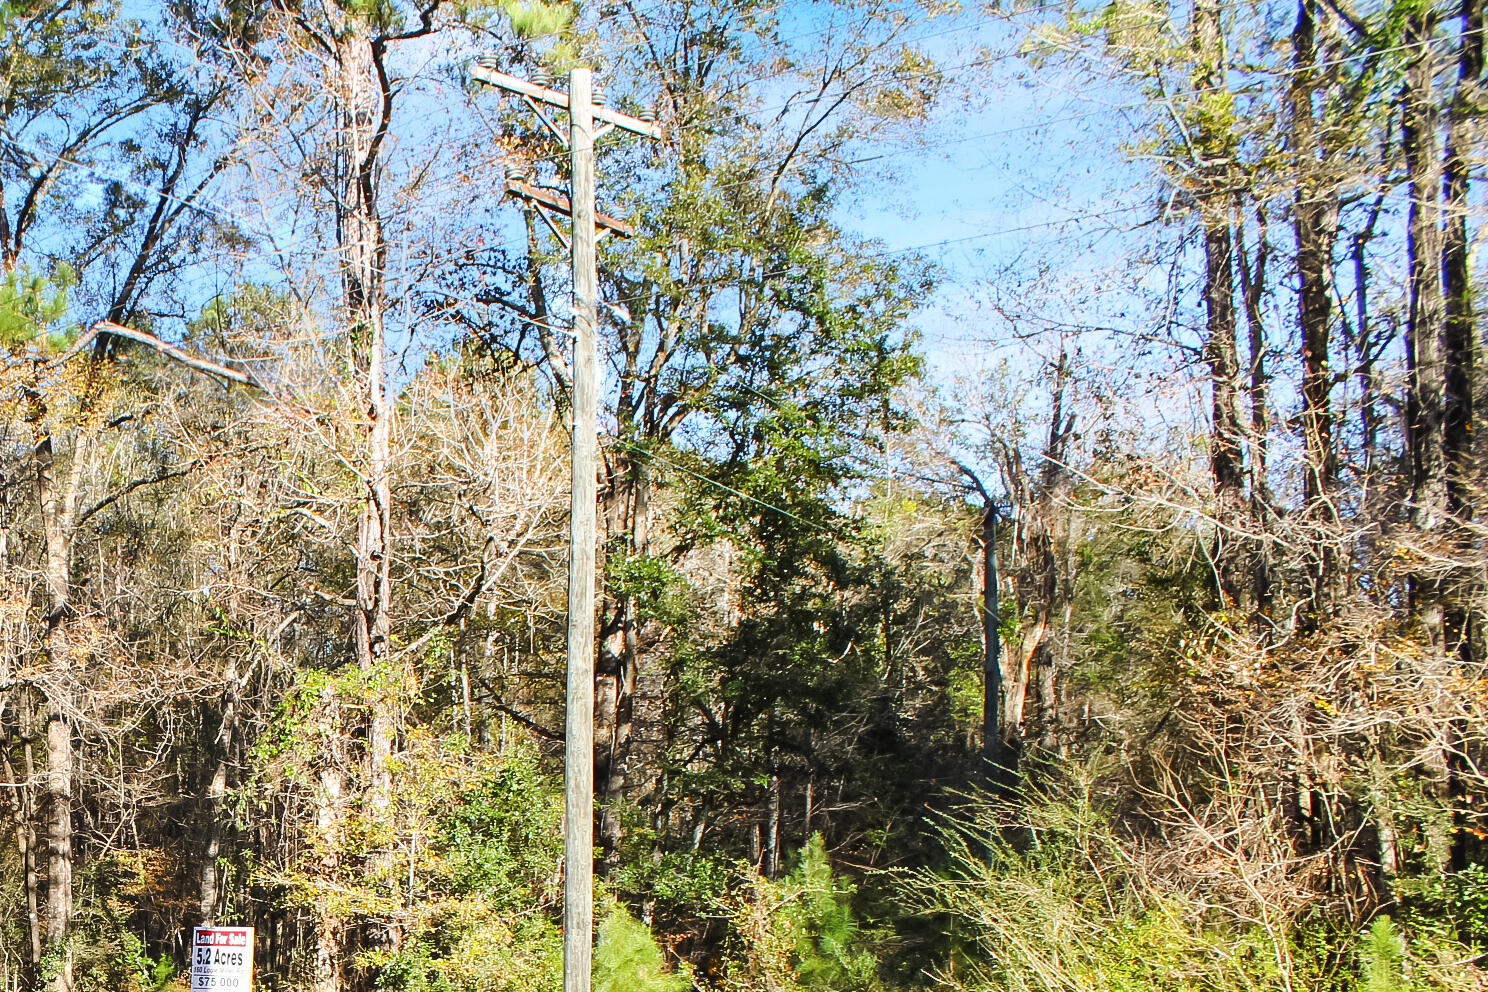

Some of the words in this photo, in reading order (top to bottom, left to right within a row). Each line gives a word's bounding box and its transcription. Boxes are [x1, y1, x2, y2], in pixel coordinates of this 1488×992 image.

[196, 932, 214, 944] Land
[215, 932, 228, 945] For
[229, 932, 246, 945] Sale
[196, 947, 212, 965] 5.2
[213, 948, 243, 966] Acres
